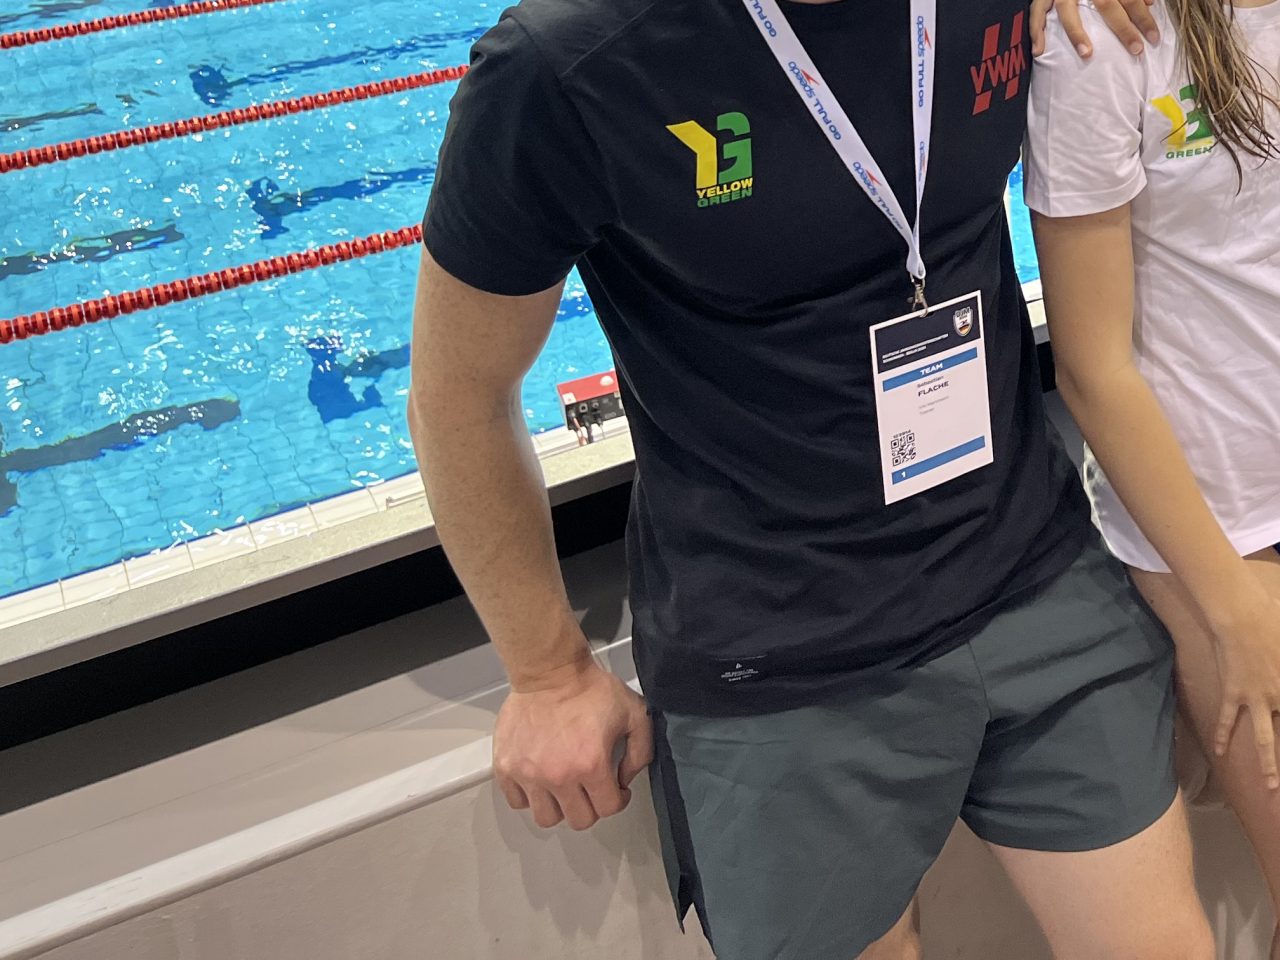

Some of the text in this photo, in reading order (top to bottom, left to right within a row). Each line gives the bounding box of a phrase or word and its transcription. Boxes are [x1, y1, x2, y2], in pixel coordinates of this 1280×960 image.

[764, 20, 777, 38] GO
[788, 61, 842, 140] GO FULL speedo
[1165, 146, 1212, 159] GREEN
[696, 177, 753, 199] YELLOW
[853, 161, 877, 196] speedo
[697, 188, 753, 208] GREEN
[919, 362, 943, 376] TEAM
[918, 381, 949, 397] FLACHE
